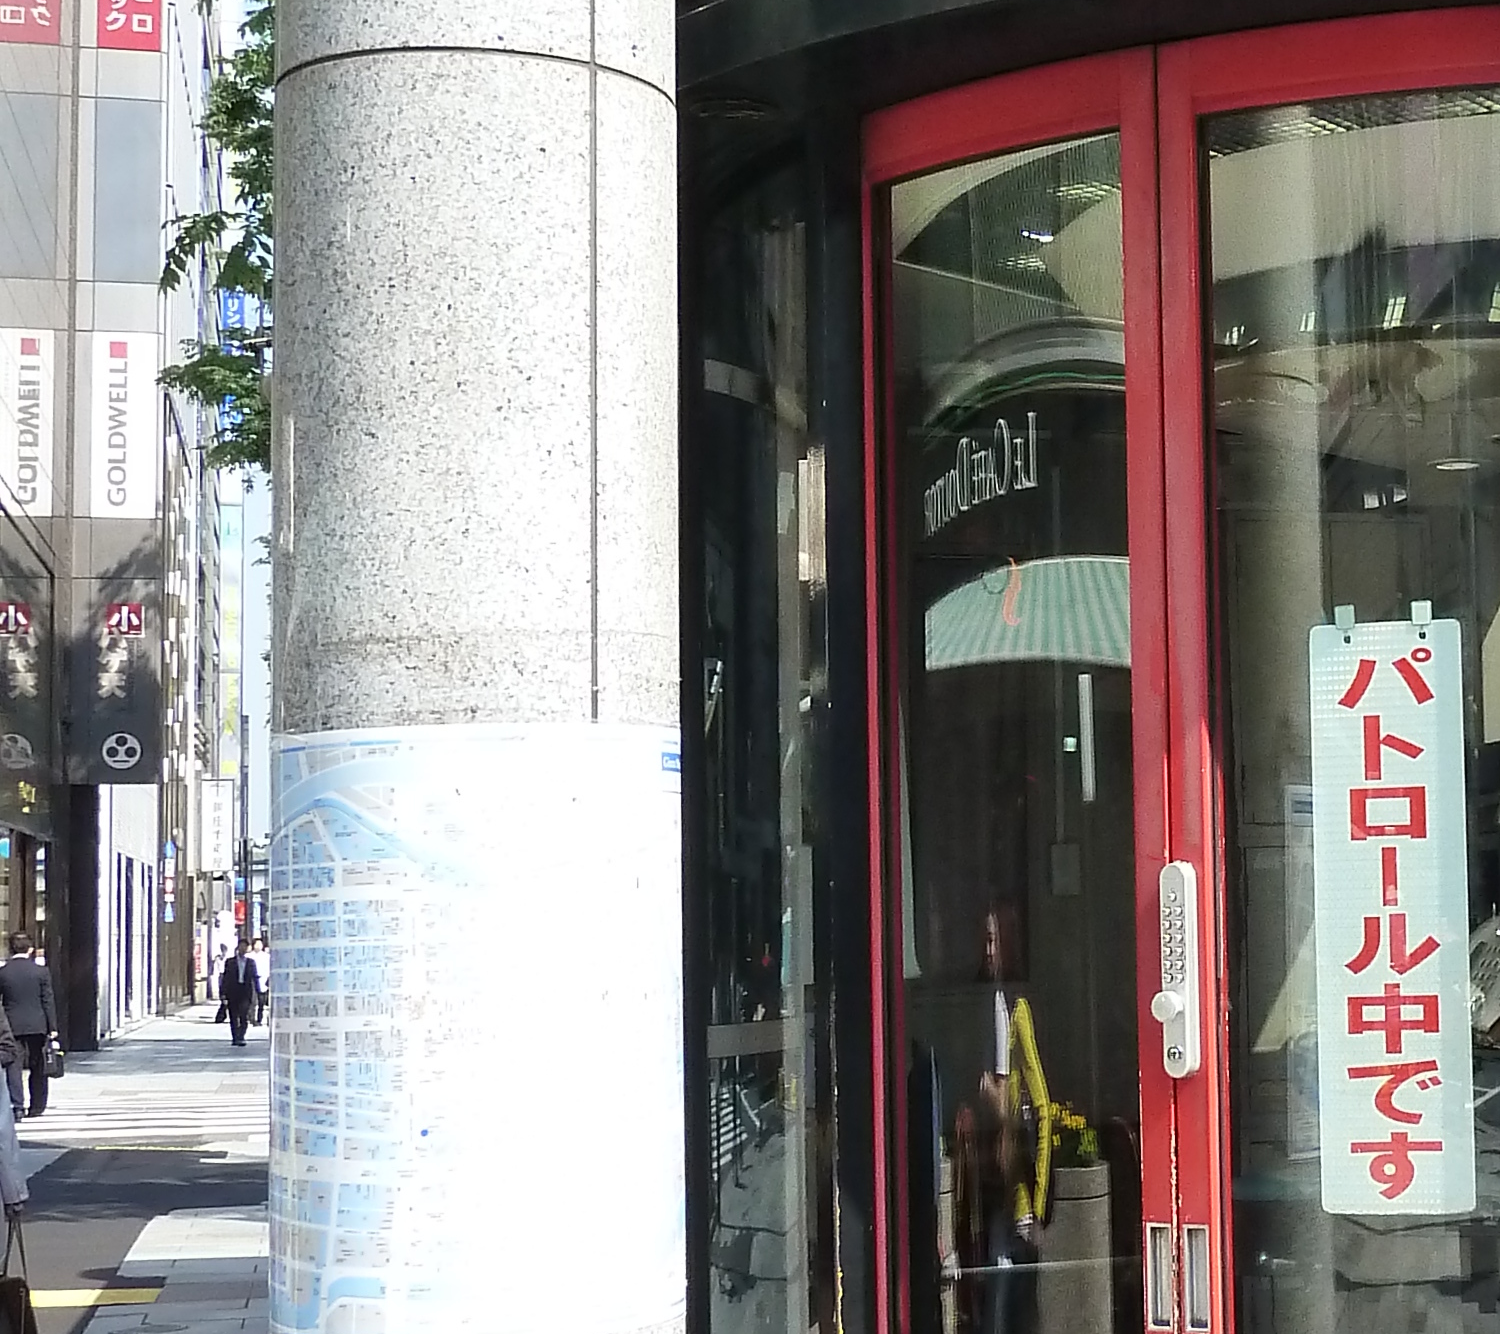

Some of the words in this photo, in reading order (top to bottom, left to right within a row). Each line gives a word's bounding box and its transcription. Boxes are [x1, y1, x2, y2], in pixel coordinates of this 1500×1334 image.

[107, 360, 128, 507] GOLDWELL
[1337, 646, 1443, 1200] パトロール中です
